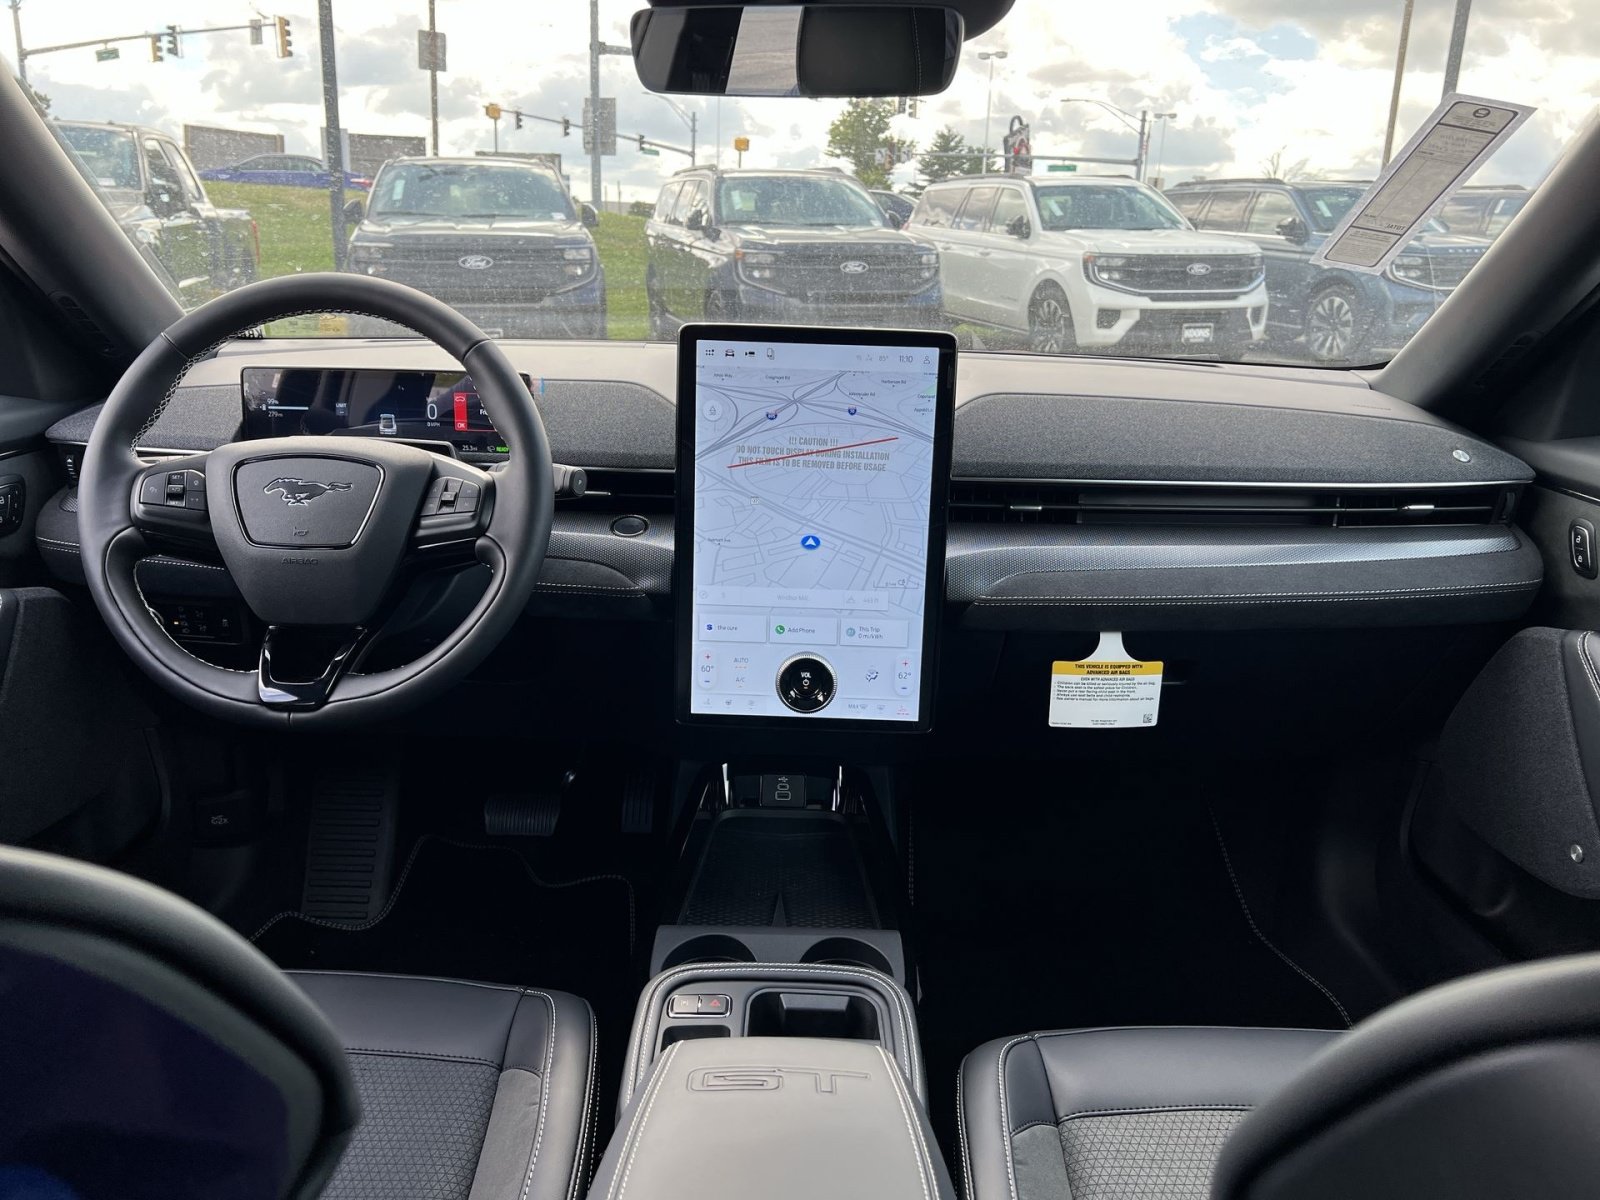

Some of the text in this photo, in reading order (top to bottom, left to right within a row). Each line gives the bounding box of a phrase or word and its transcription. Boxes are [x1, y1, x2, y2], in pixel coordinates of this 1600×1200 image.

[427, 403, 437, 420] 0
[799, 437, 828, 446] CAUTION
[763, 446, 782, 454] TOUCH
[843, 451, 890, 460] INSTALLATION
[739, 456, 754, 464] THIS
[782, 459, 790, 467] TO
[802, 460, 834, 469] REMOVED
[837, 461, 861, 470] BEFORE
[863, 462, 886, 471] USAGE
[687, 1065, 871, 1094] GT
